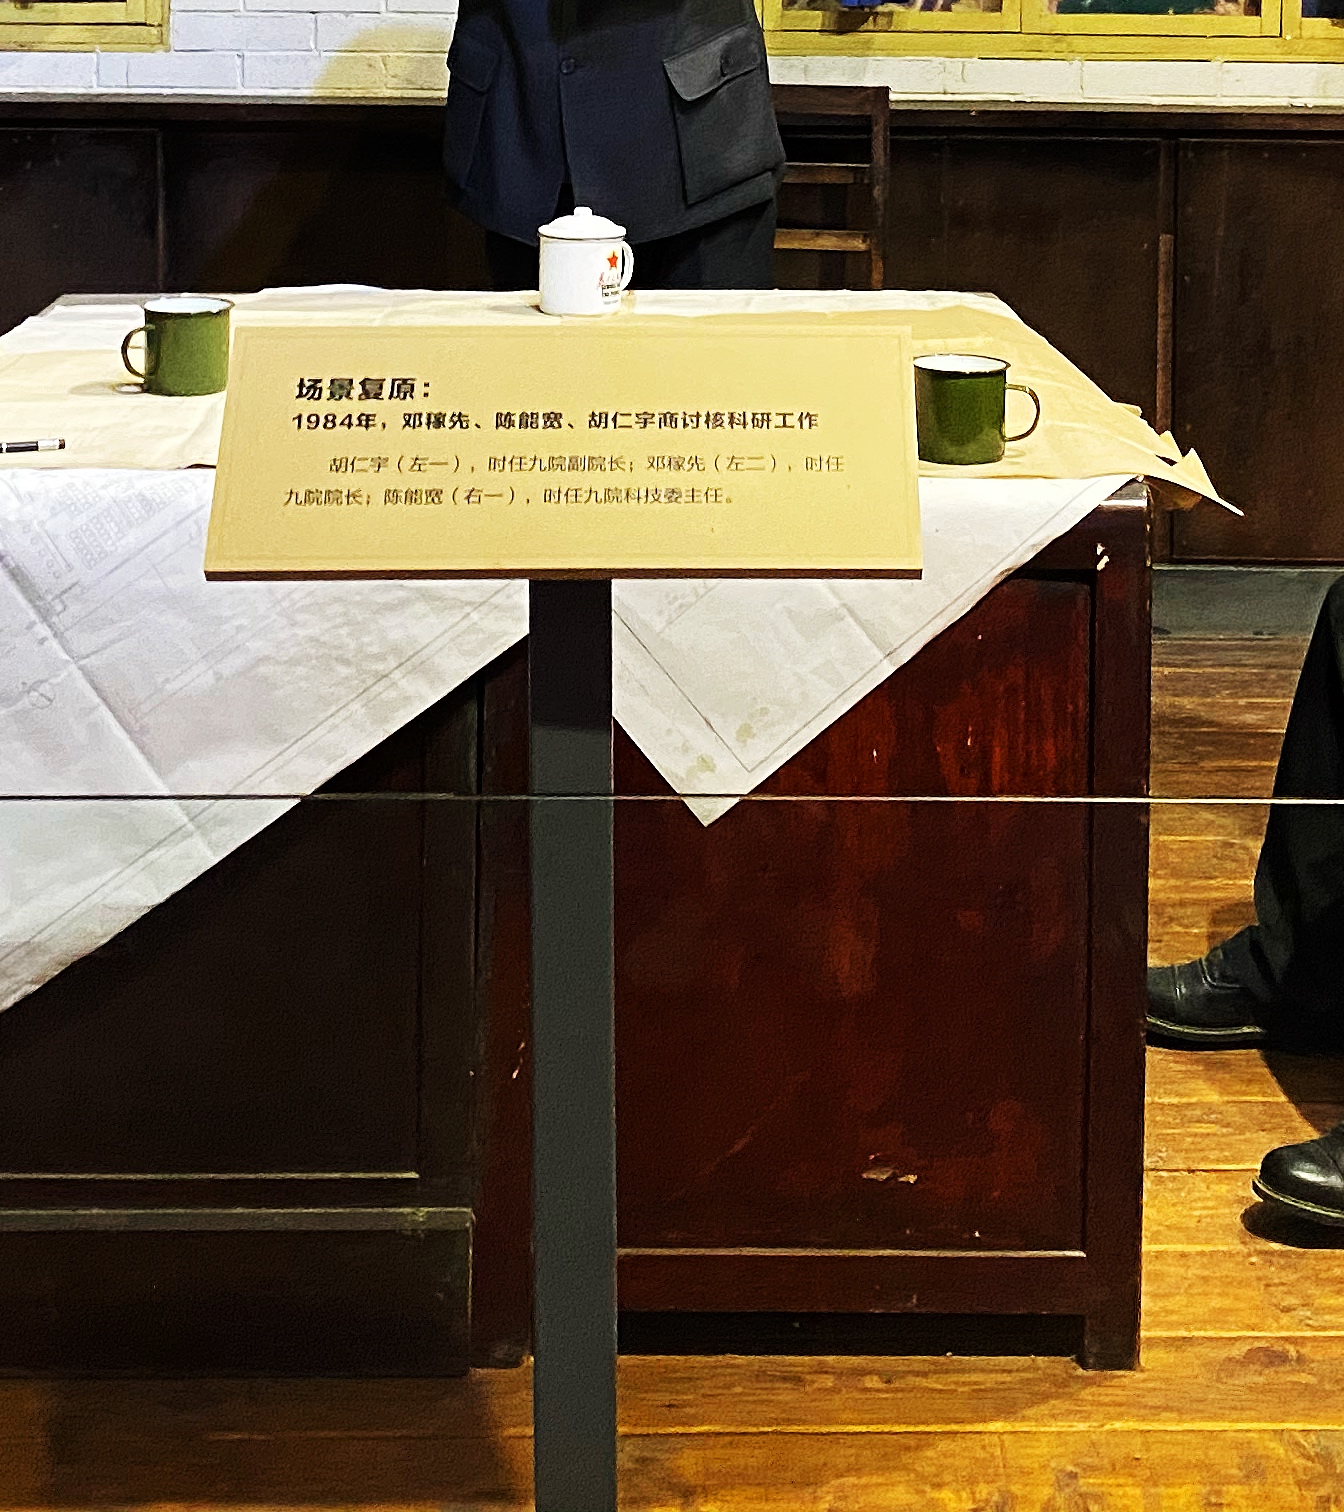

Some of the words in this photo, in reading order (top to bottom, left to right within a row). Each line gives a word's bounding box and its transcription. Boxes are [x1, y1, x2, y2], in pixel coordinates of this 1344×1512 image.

[296, 377, 430, 401] 场景复原：
[292, 411, 819, 431] 1984年，邓稼先、陈能宽、胡仁宇商讨核科研工作
